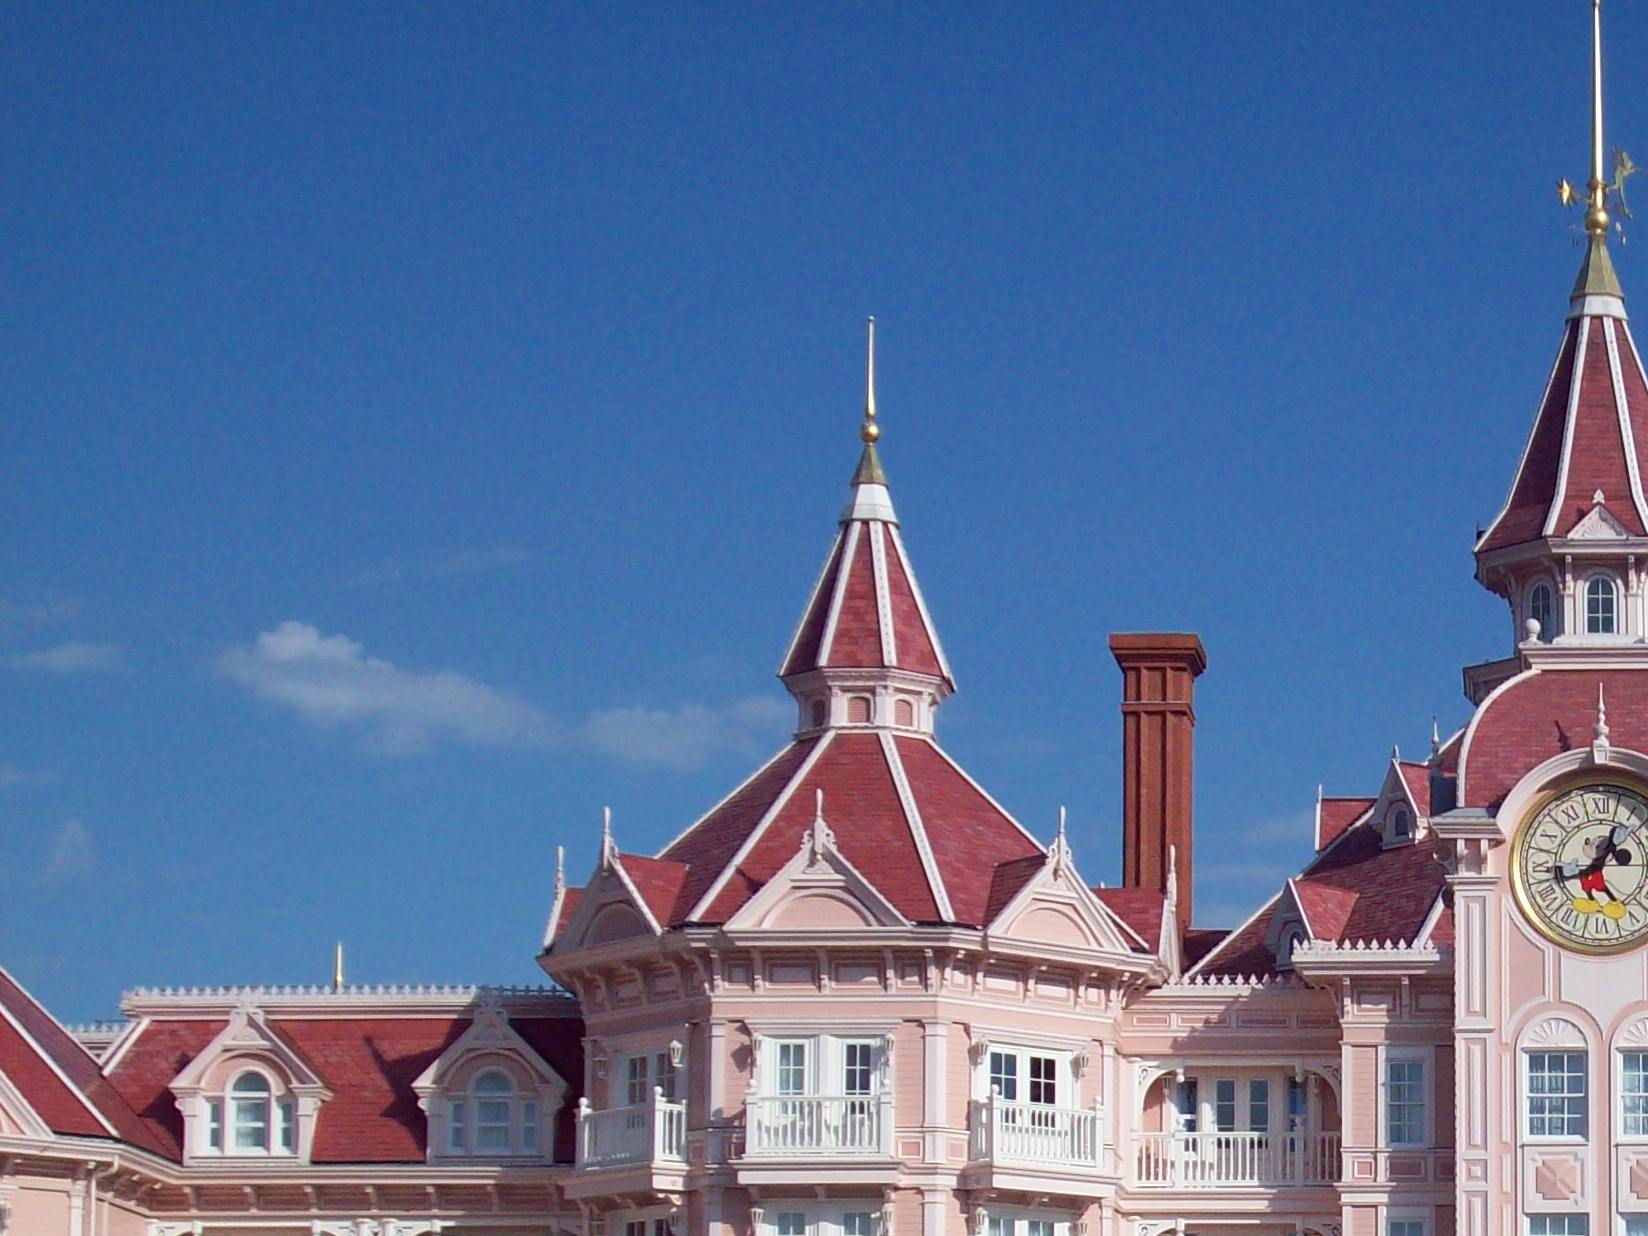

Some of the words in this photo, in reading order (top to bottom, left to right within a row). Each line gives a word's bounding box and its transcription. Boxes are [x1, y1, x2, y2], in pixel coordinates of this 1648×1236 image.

[1561, 805, 1579, 824] XI
[1591, 797, 1610, 815] XII
[1540, 830, 1558, 841] X
[1538, 884, 1556, 908] VIII
[1594, 917, 1610, 935] VI
